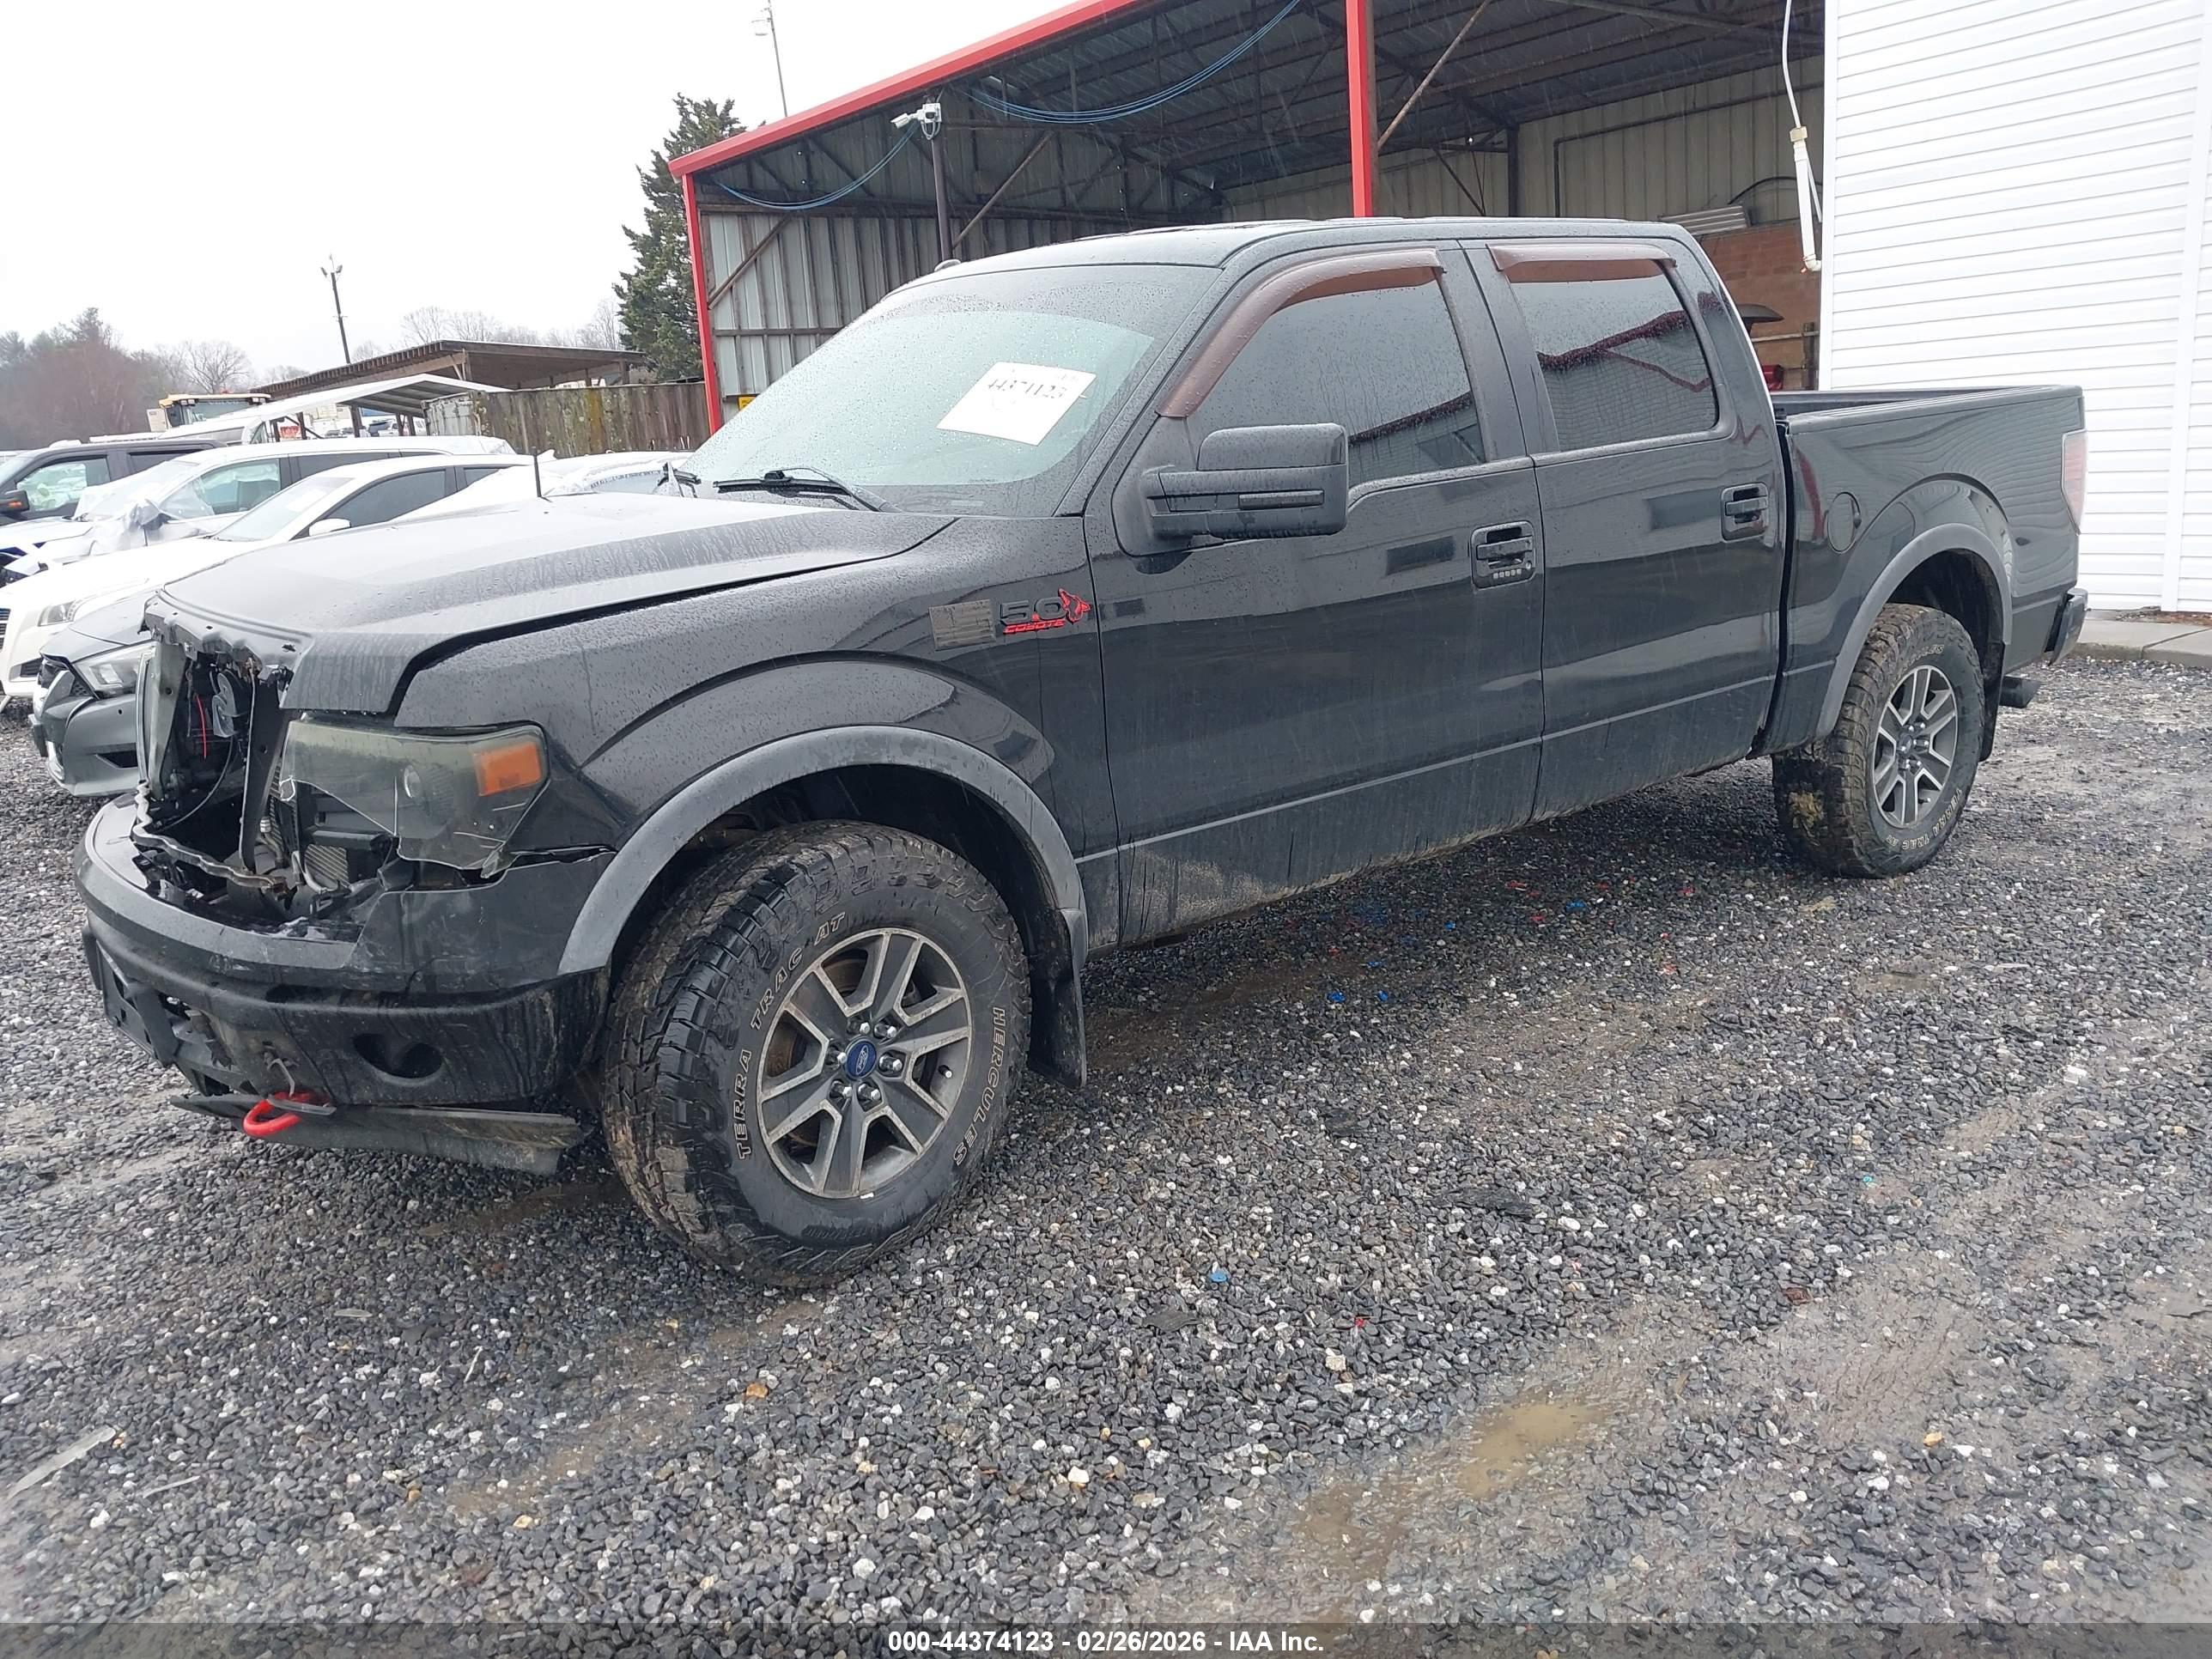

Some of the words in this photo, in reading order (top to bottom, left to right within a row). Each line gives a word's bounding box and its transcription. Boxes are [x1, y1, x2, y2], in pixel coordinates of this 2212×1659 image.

[1003, 618, 1066, 635] COYOTE
[733, 1048, 753, 1159] TERRA
[750, 948, 804, 1030] TRAC
[814, 912, 846, 945] AT
[953, 1006, 1006, 1166] HERCULES
